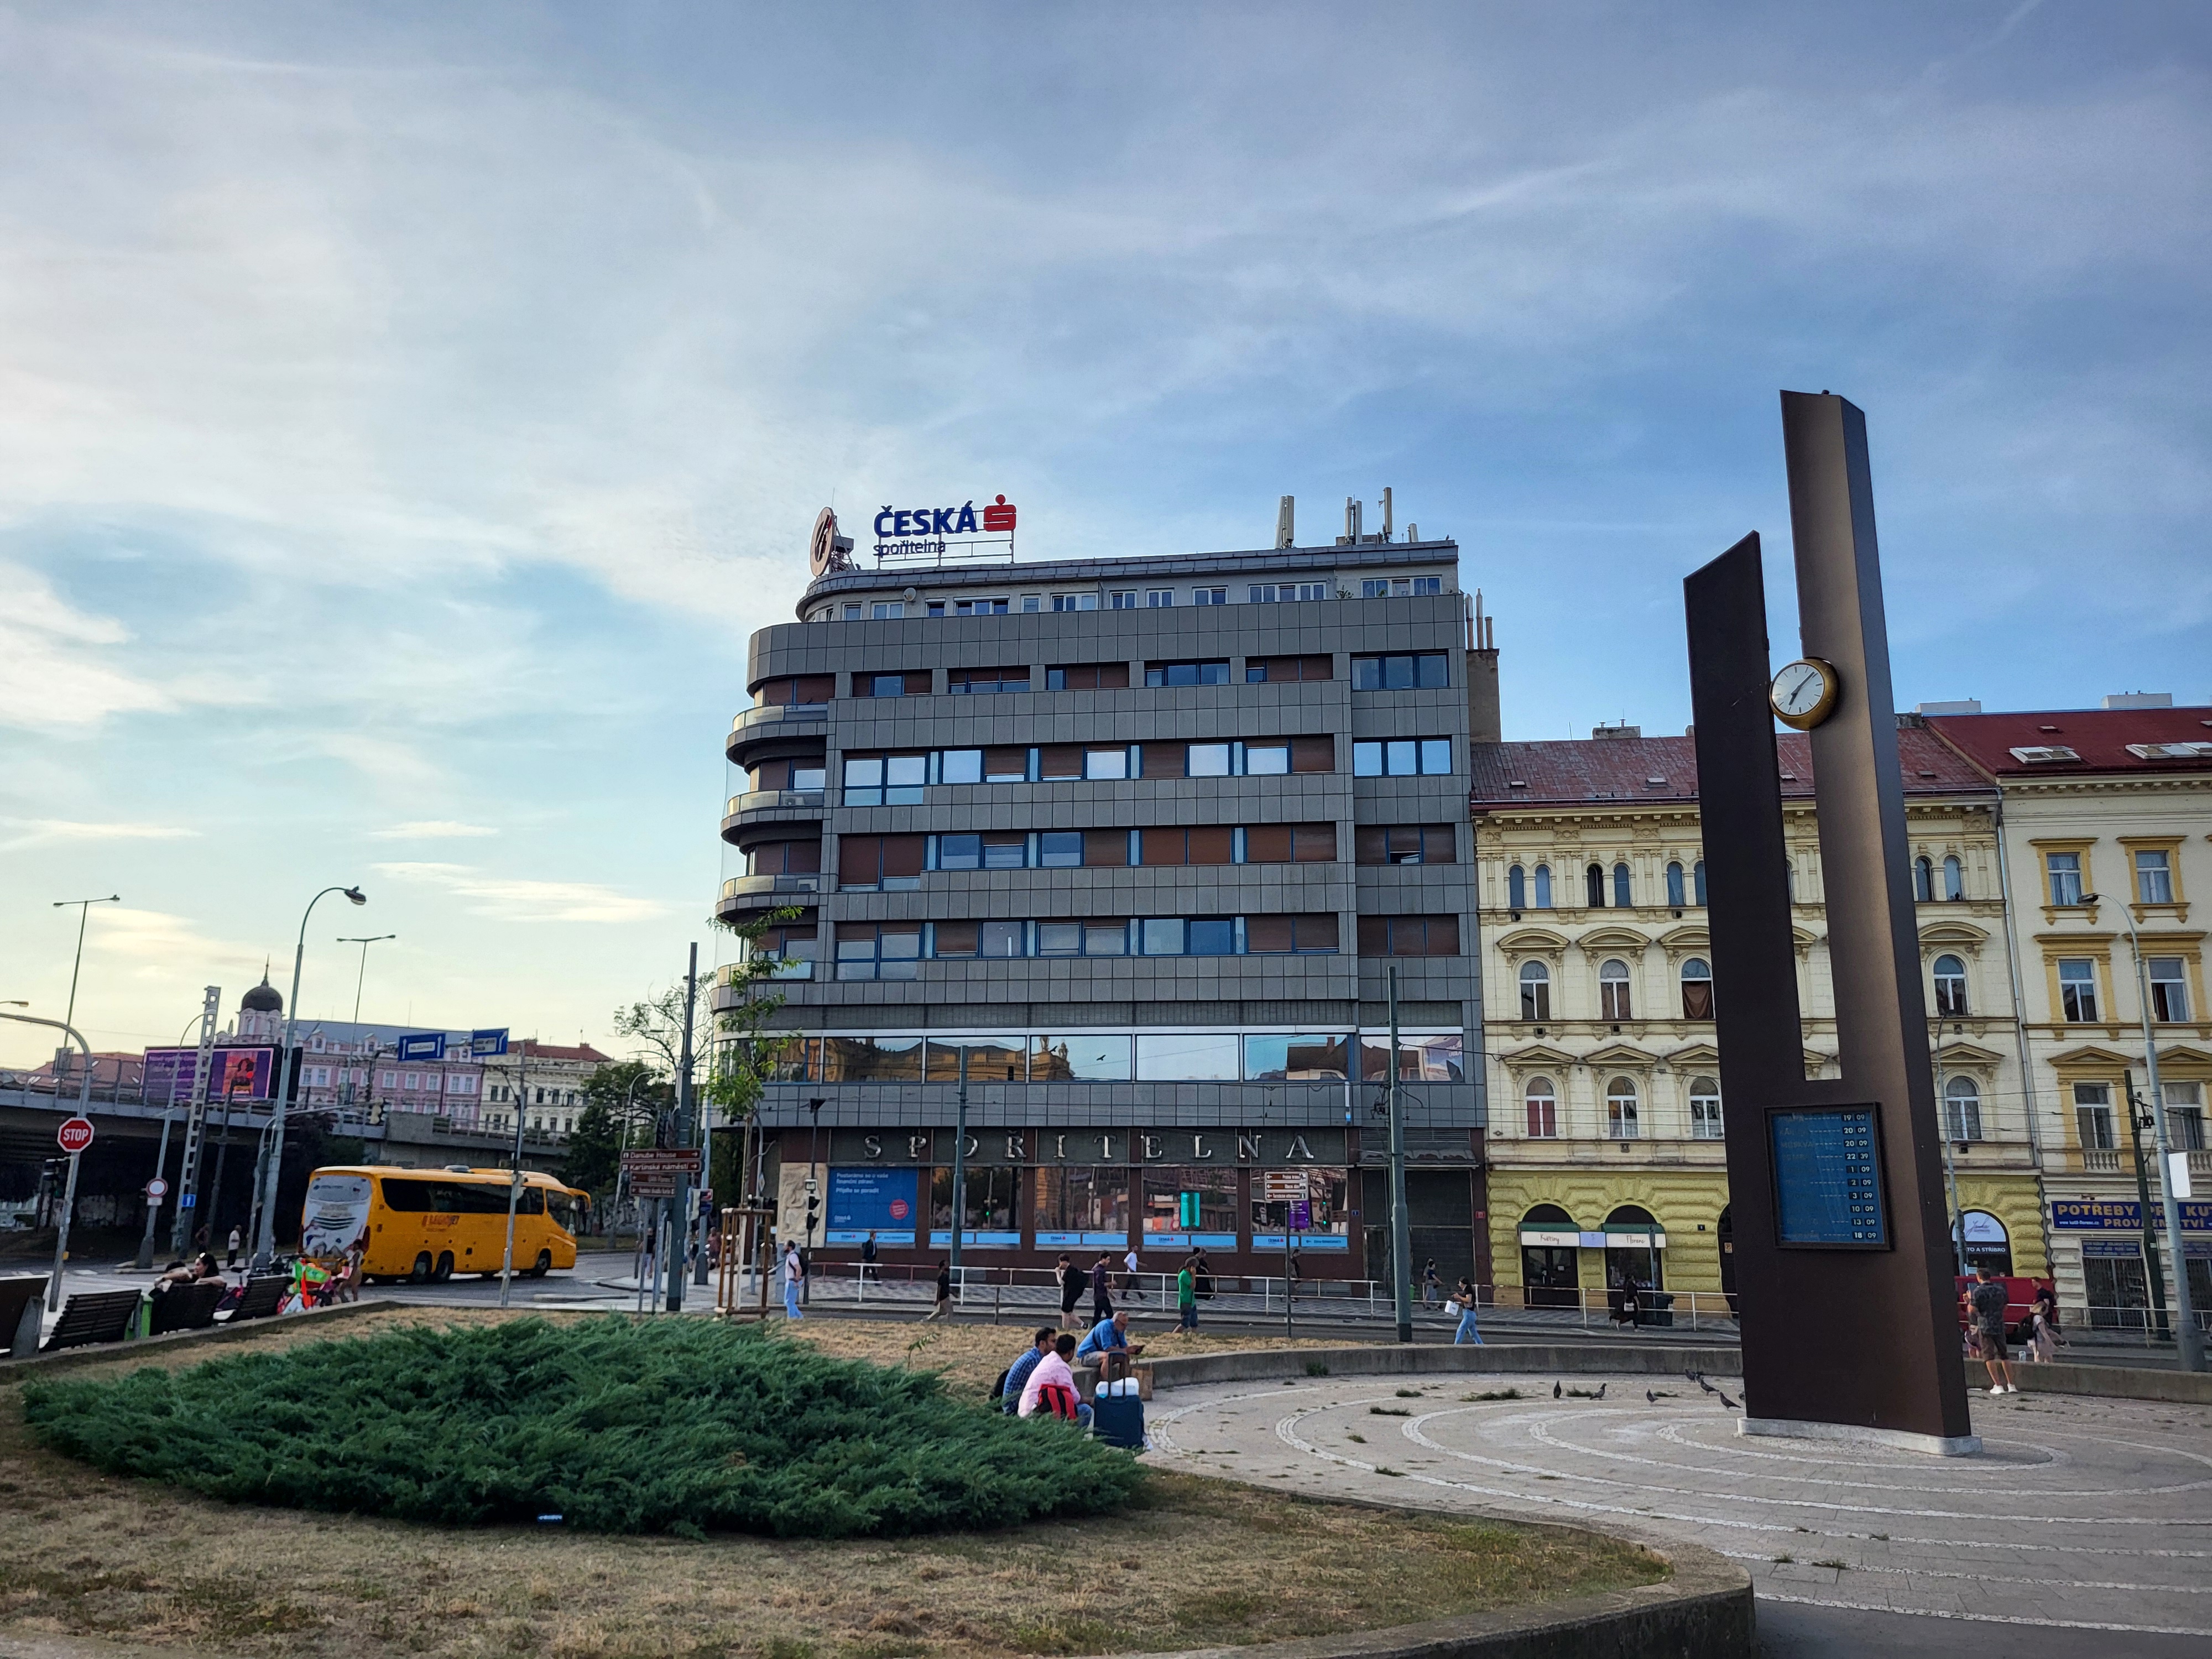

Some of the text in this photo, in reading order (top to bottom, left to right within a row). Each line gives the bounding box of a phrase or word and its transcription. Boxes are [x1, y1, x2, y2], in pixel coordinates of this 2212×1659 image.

[874, 500, 978, 538] ČESKÁ
[873, 539, 946, 558] spořitelna
[63, 1129, 88, 1141] STOP
[2057, 1203, 2135, 1215] POTŘEBY
